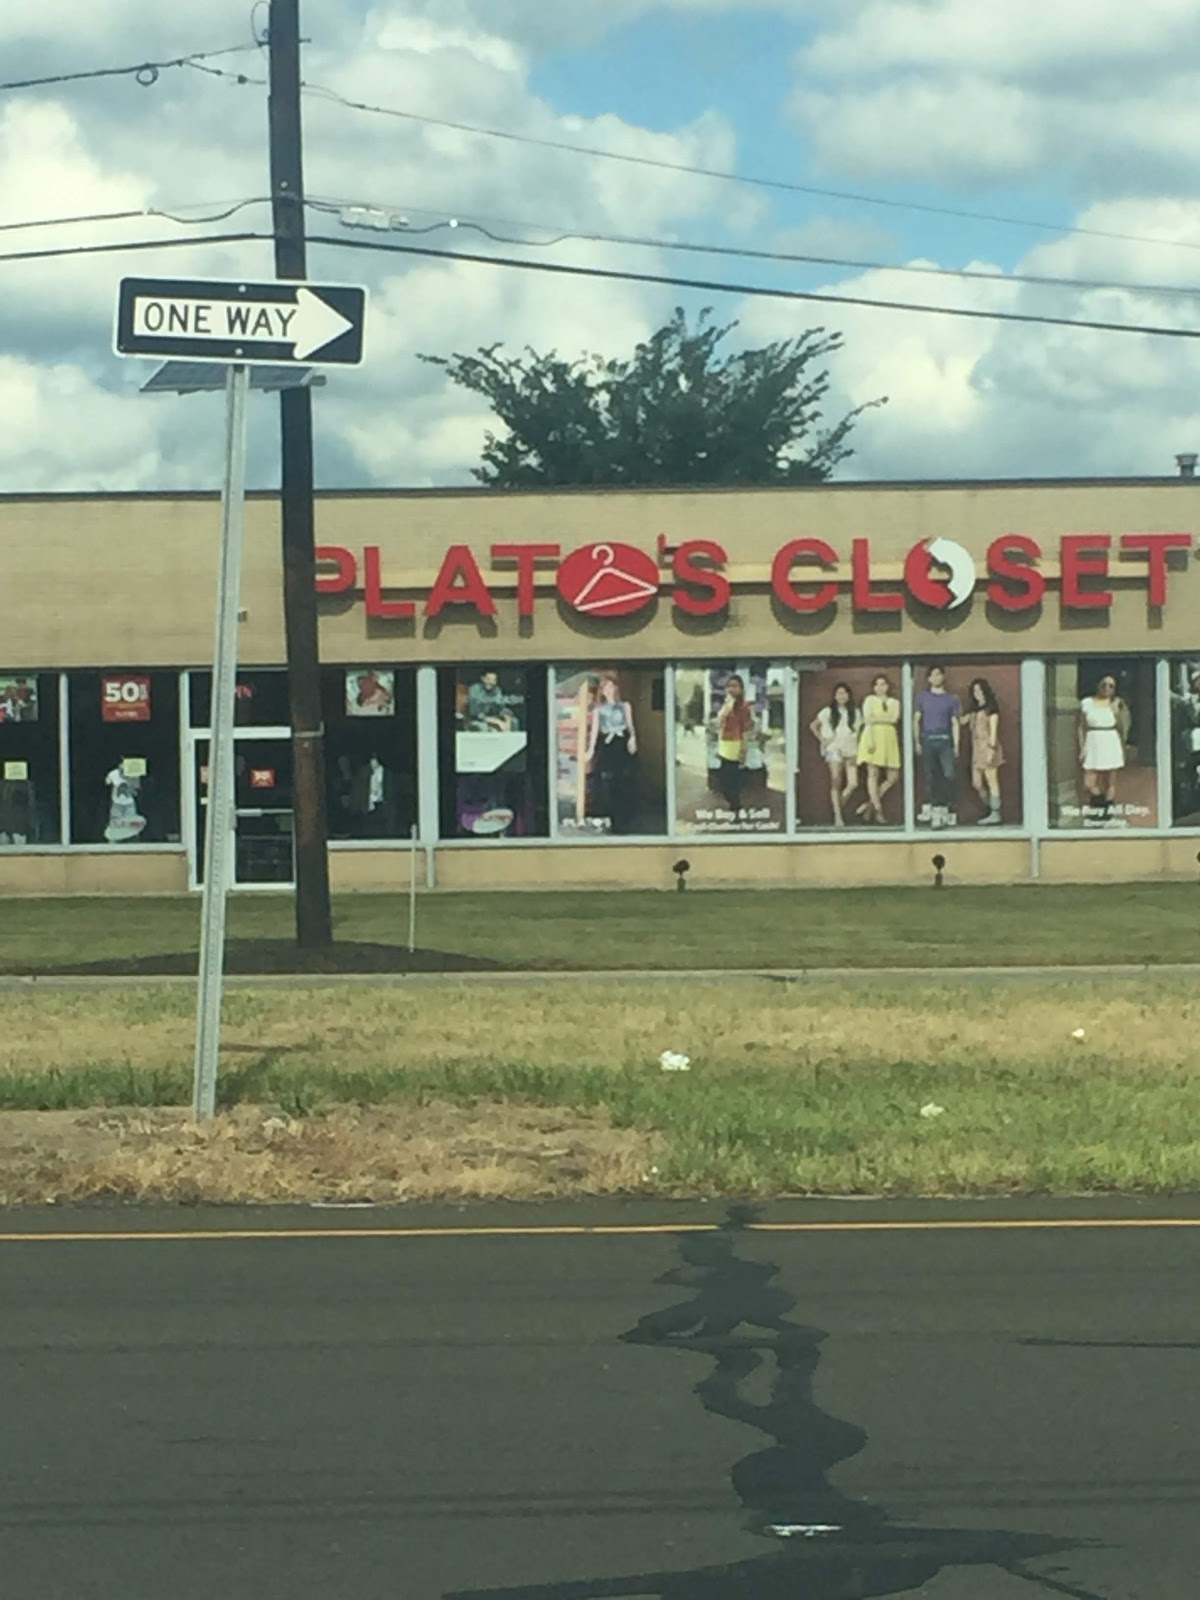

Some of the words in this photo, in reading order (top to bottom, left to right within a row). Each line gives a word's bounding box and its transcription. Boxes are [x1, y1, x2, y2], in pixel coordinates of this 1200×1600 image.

[143, 302, 212, 333] ONE
[226, 306, 296, 337] WAY
[315, 534, 732, 617] PLATO'S
[771, 533, 1192, 613] CLOSET
